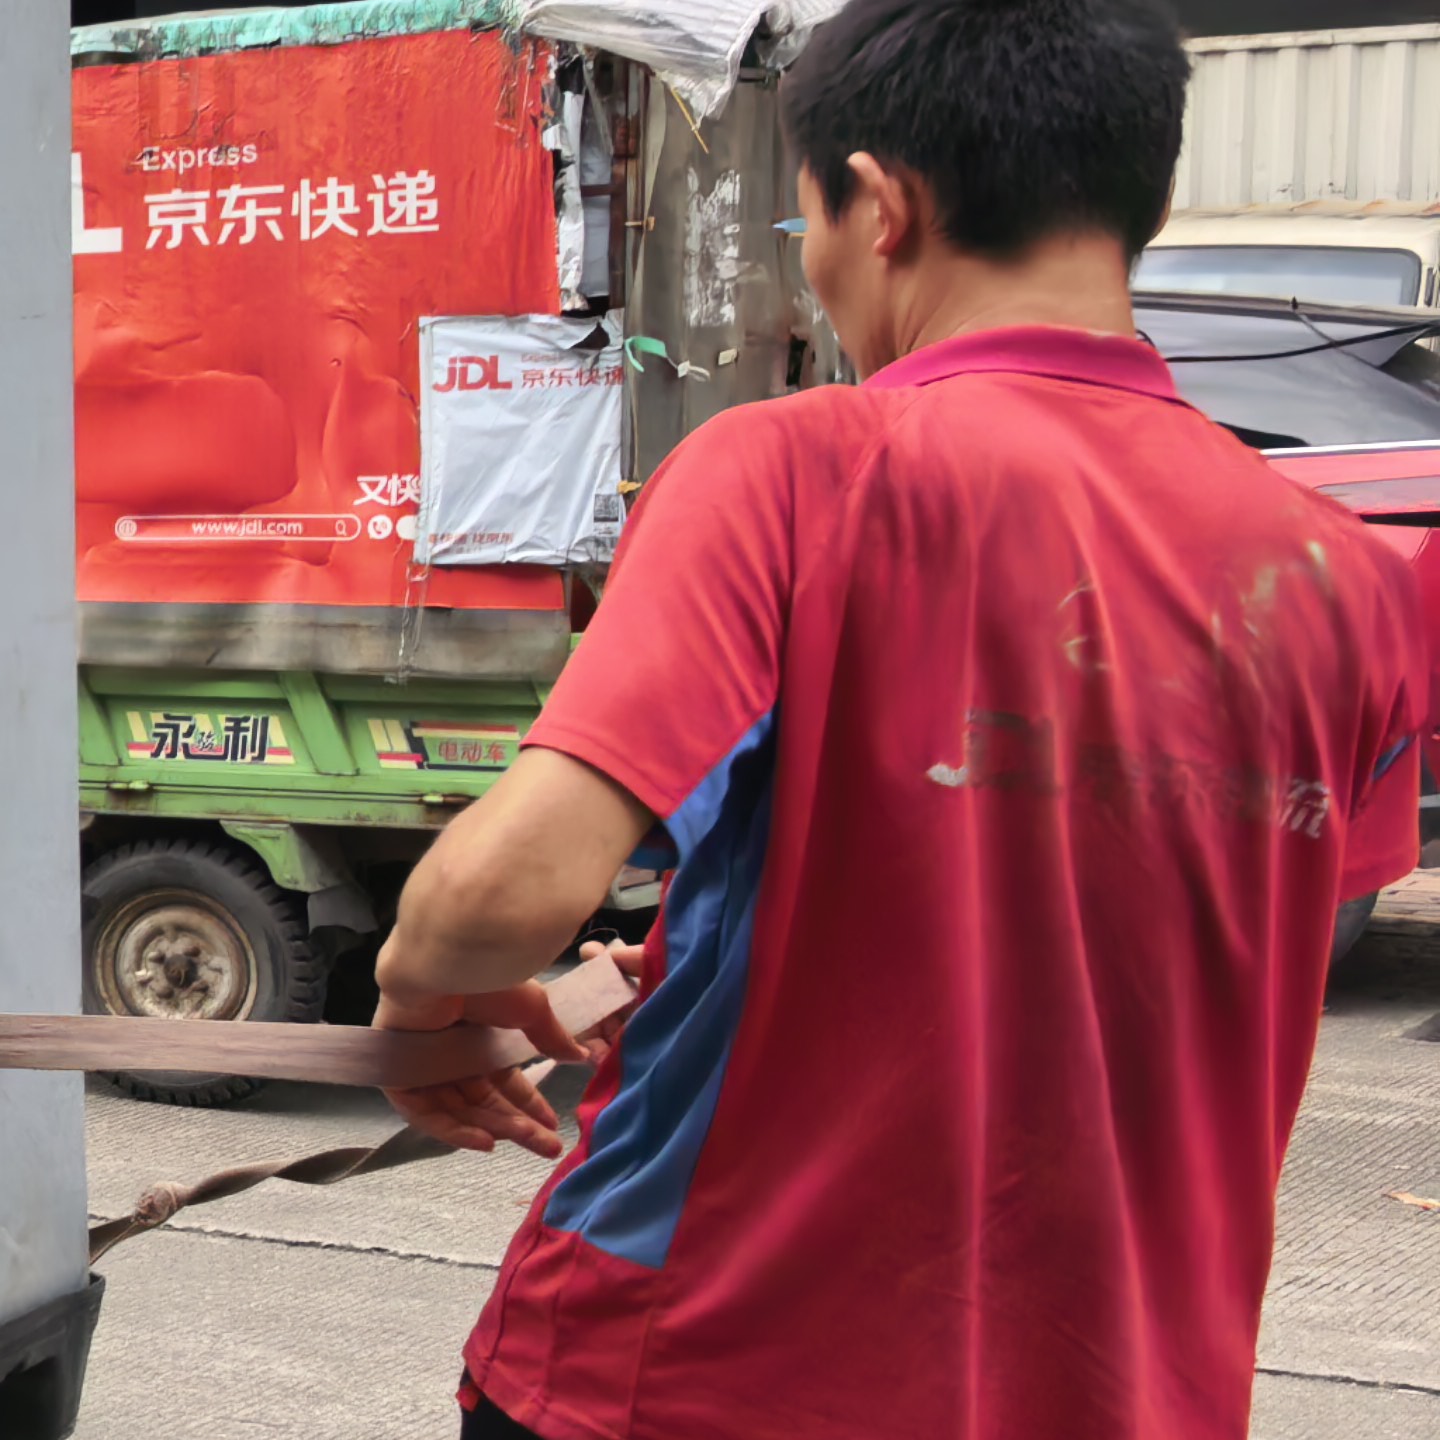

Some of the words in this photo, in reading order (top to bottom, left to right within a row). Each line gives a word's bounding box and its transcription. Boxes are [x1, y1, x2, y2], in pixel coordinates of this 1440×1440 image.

[140, 143, 258, 174] Express
[143, 169, 441, 251] 京东快递
[432, 355, 513, 393] JDL
[192, 517, 304, 536] www.jdl.com
[438, 739, 506, 763] 电动车
